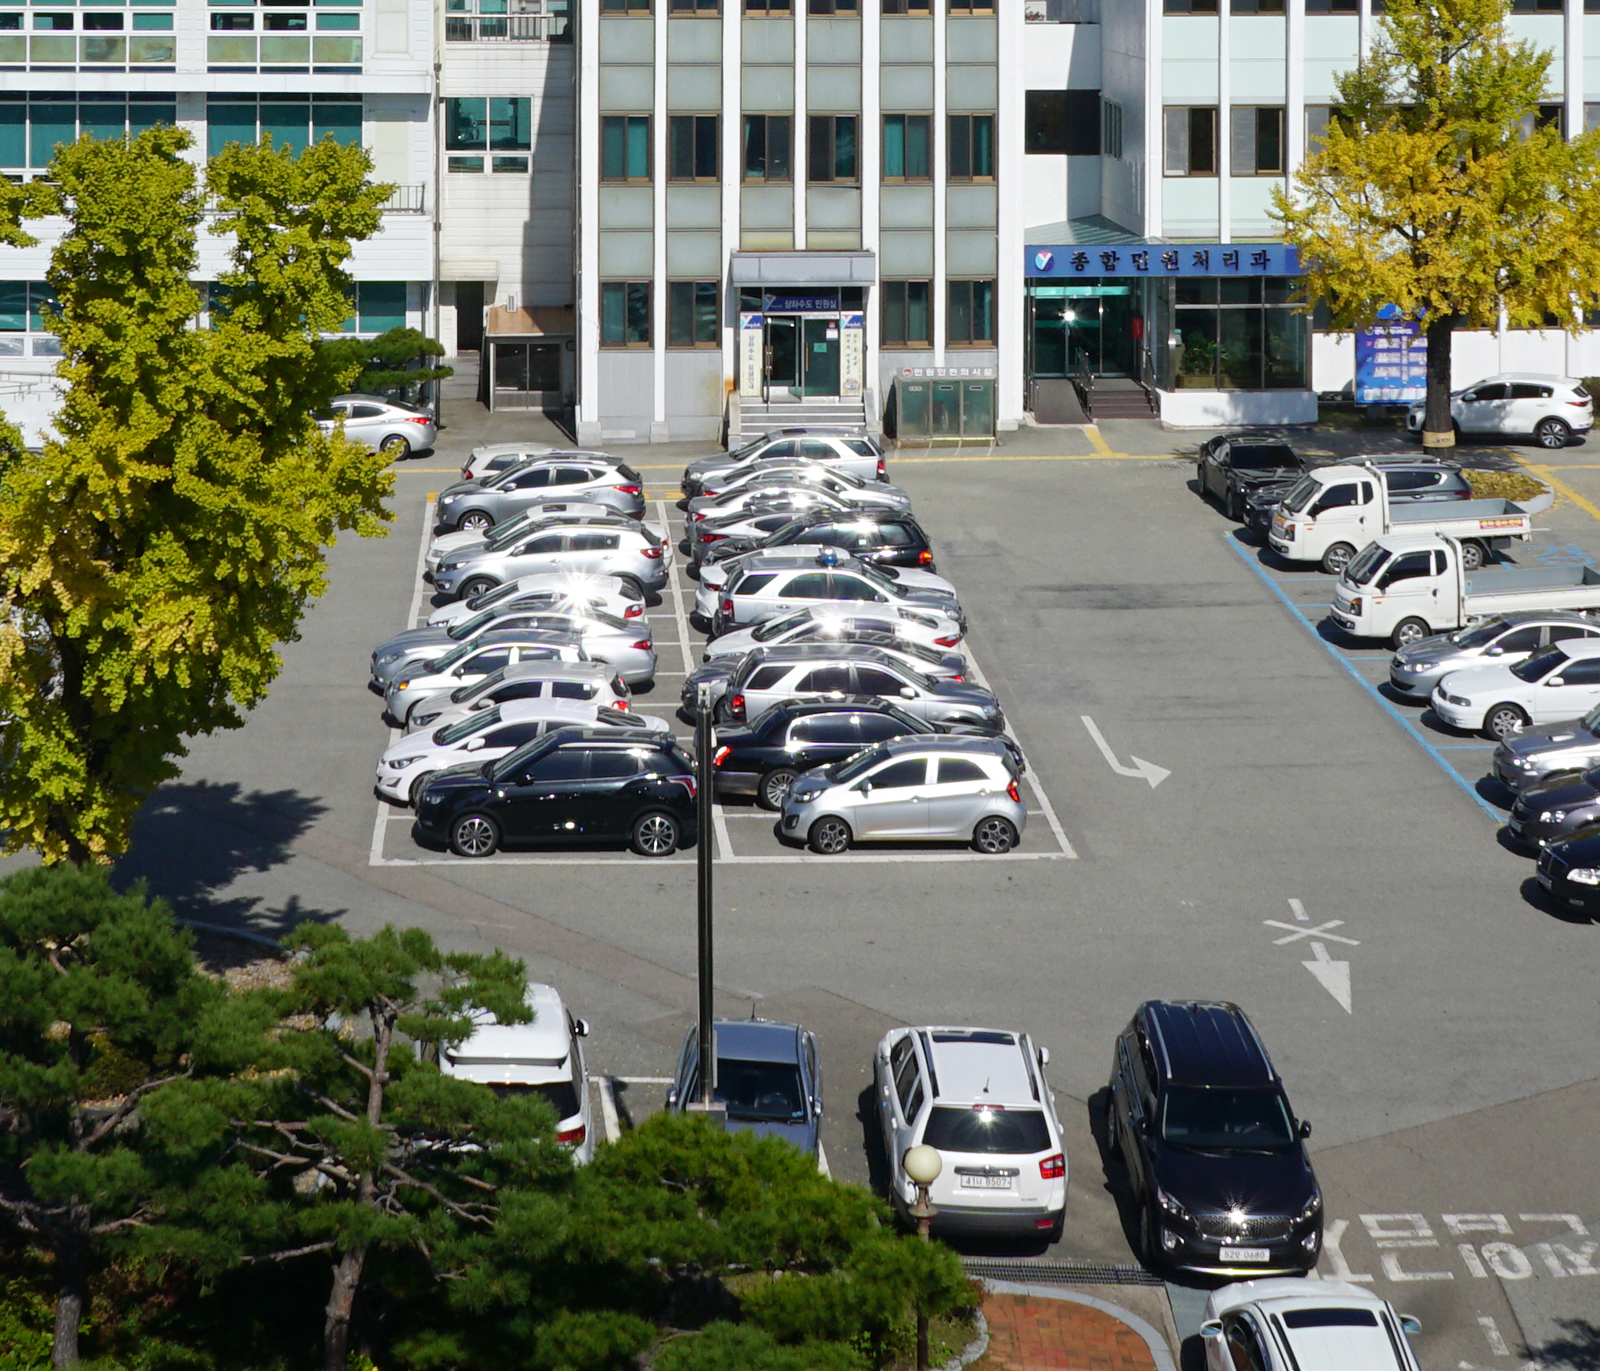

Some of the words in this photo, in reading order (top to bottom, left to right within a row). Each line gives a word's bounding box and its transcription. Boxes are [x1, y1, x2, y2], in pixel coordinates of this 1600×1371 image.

[1070, 250, 1271, 271] 종합민원처리과
[785, 299, 813, 309] 상하수도
[815, 299, 837, 309] 민원실
[914, 368, 992, 376] 민원인편의시설
